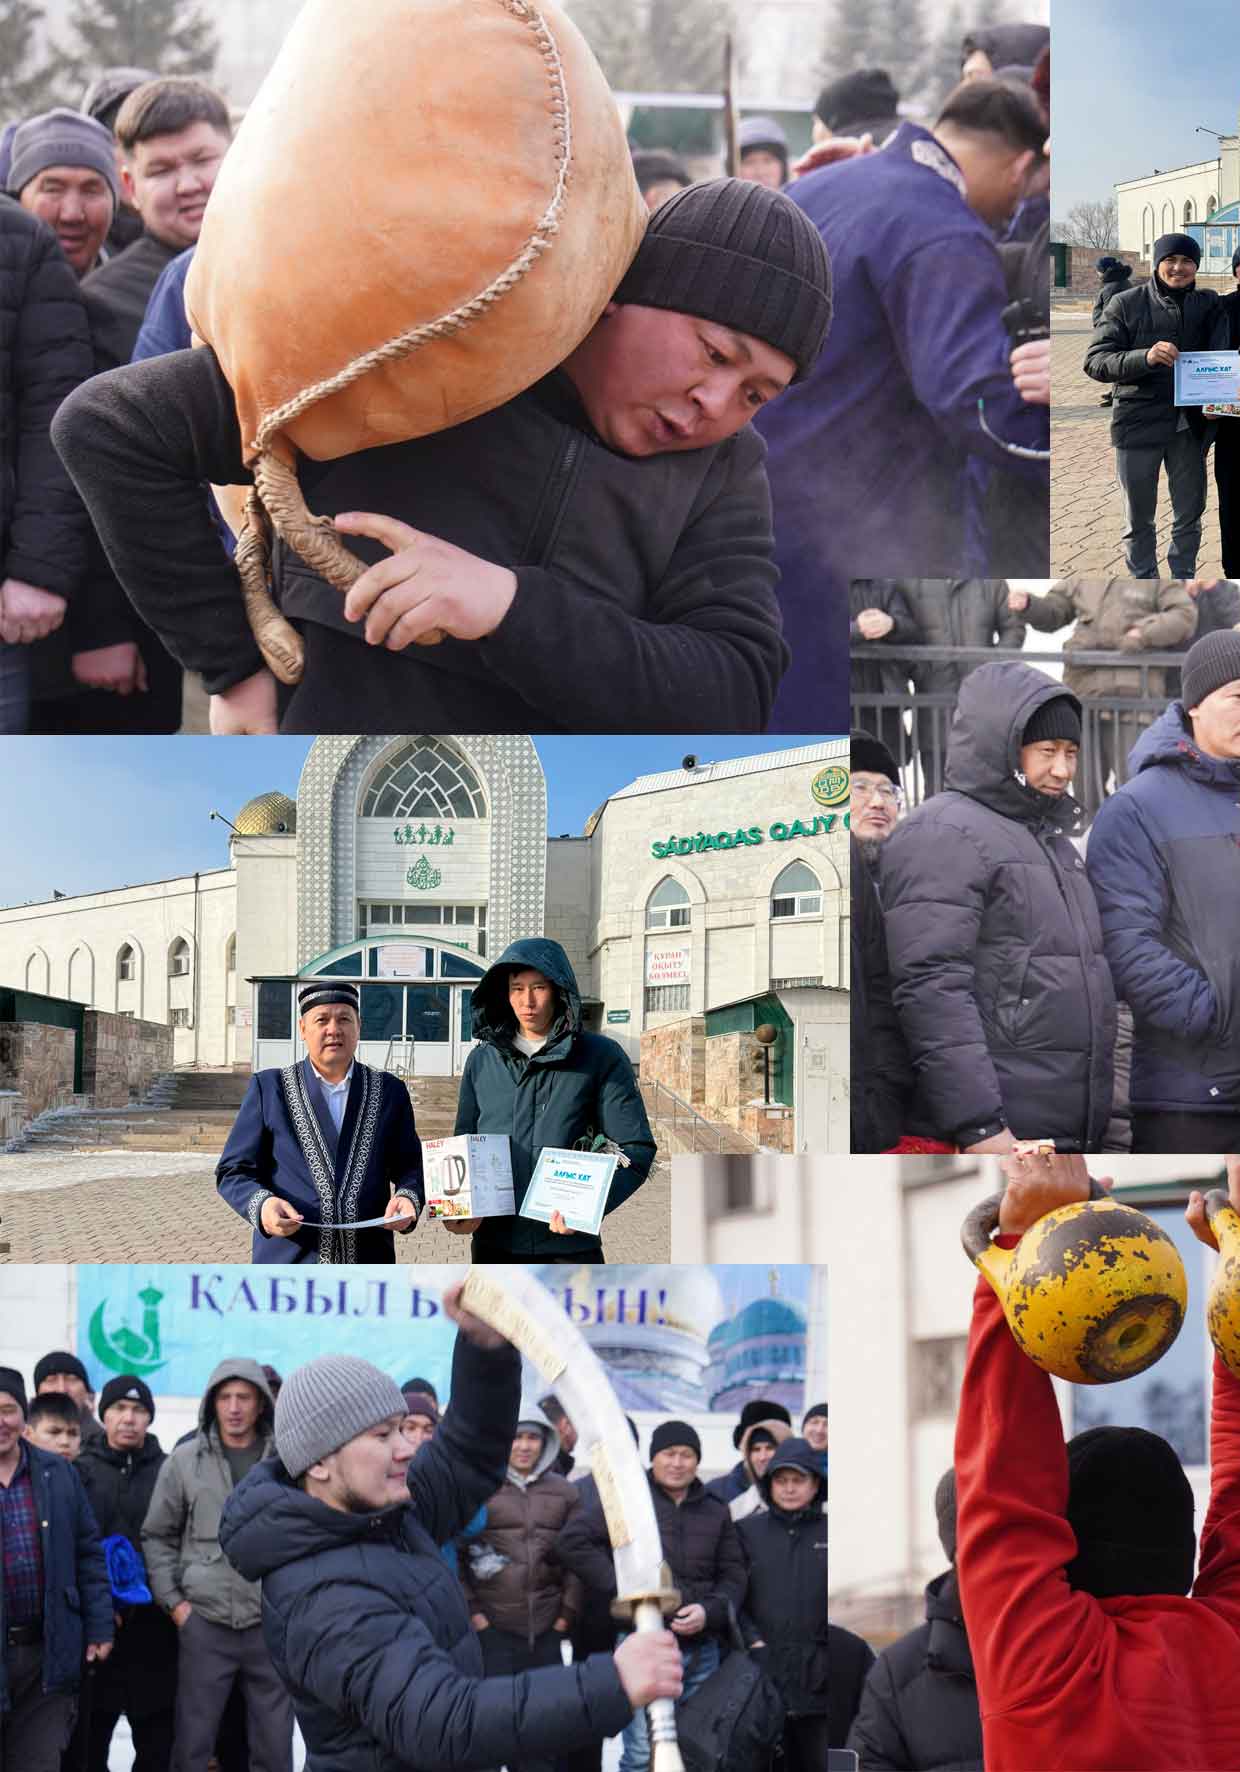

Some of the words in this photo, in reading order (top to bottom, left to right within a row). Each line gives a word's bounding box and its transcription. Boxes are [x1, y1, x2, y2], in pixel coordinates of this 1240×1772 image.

[651, 826, 763, 859] SÁDÝAQAS
[768, 813, 837, 841] QAJY
[426, 1140, 445, 1149] HALEY
[190, 1273, 388, 1317] ҚАБЫЛ
